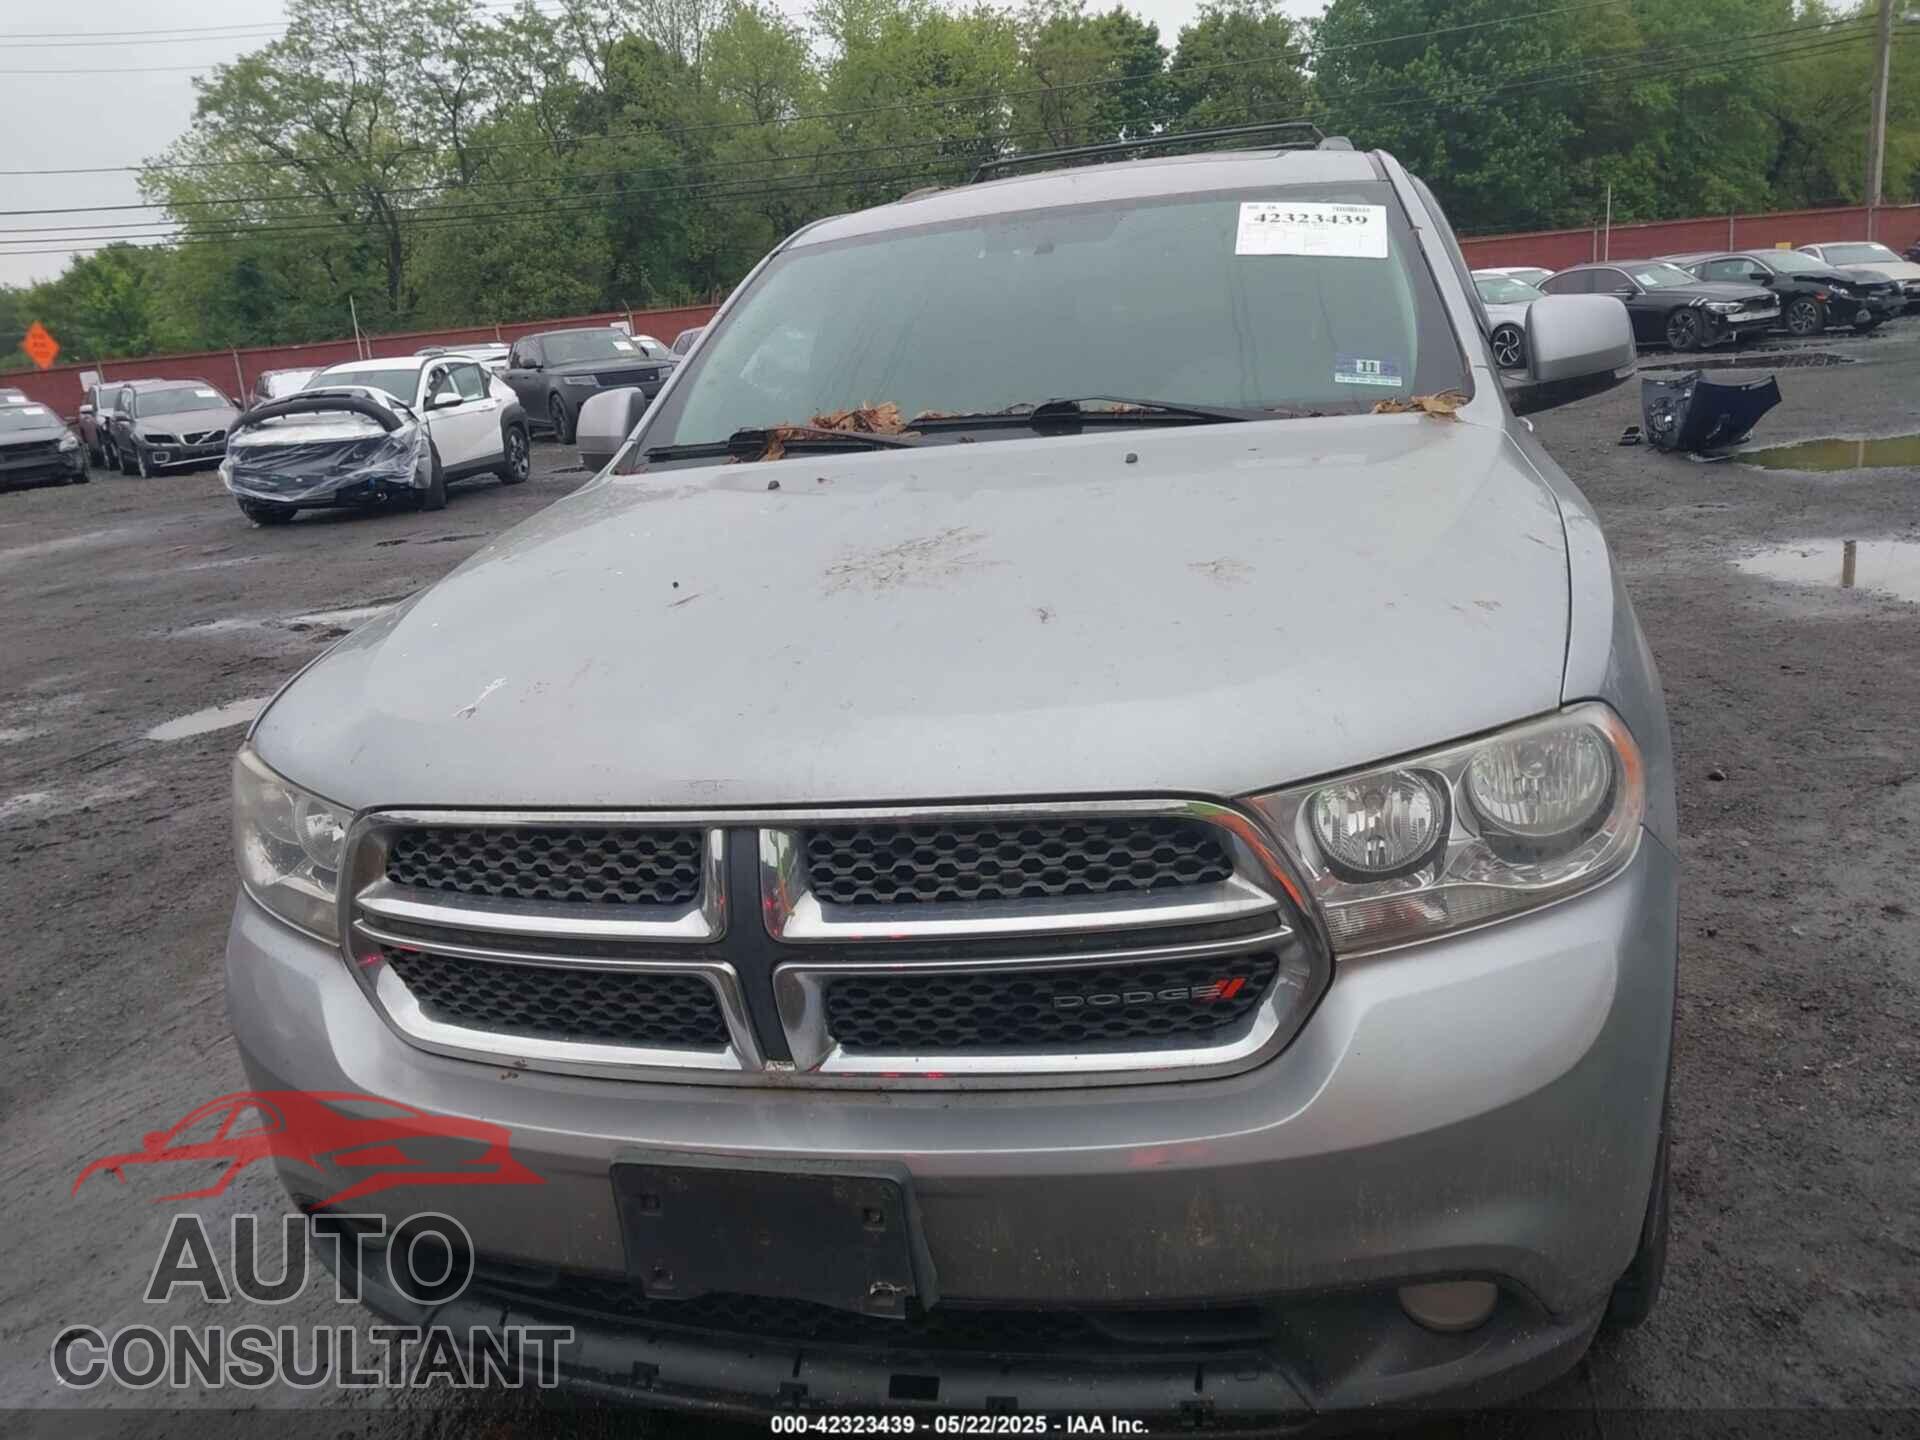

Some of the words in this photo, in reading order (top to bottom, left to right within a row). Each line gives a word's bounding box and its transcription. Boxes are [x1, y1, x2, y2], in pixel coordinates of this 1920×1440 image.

[1253, 212, 1368, 225] 42323439
[1361, 361, 1376, 373] 11
[1053, 984, 1222, 1008] DODGE
